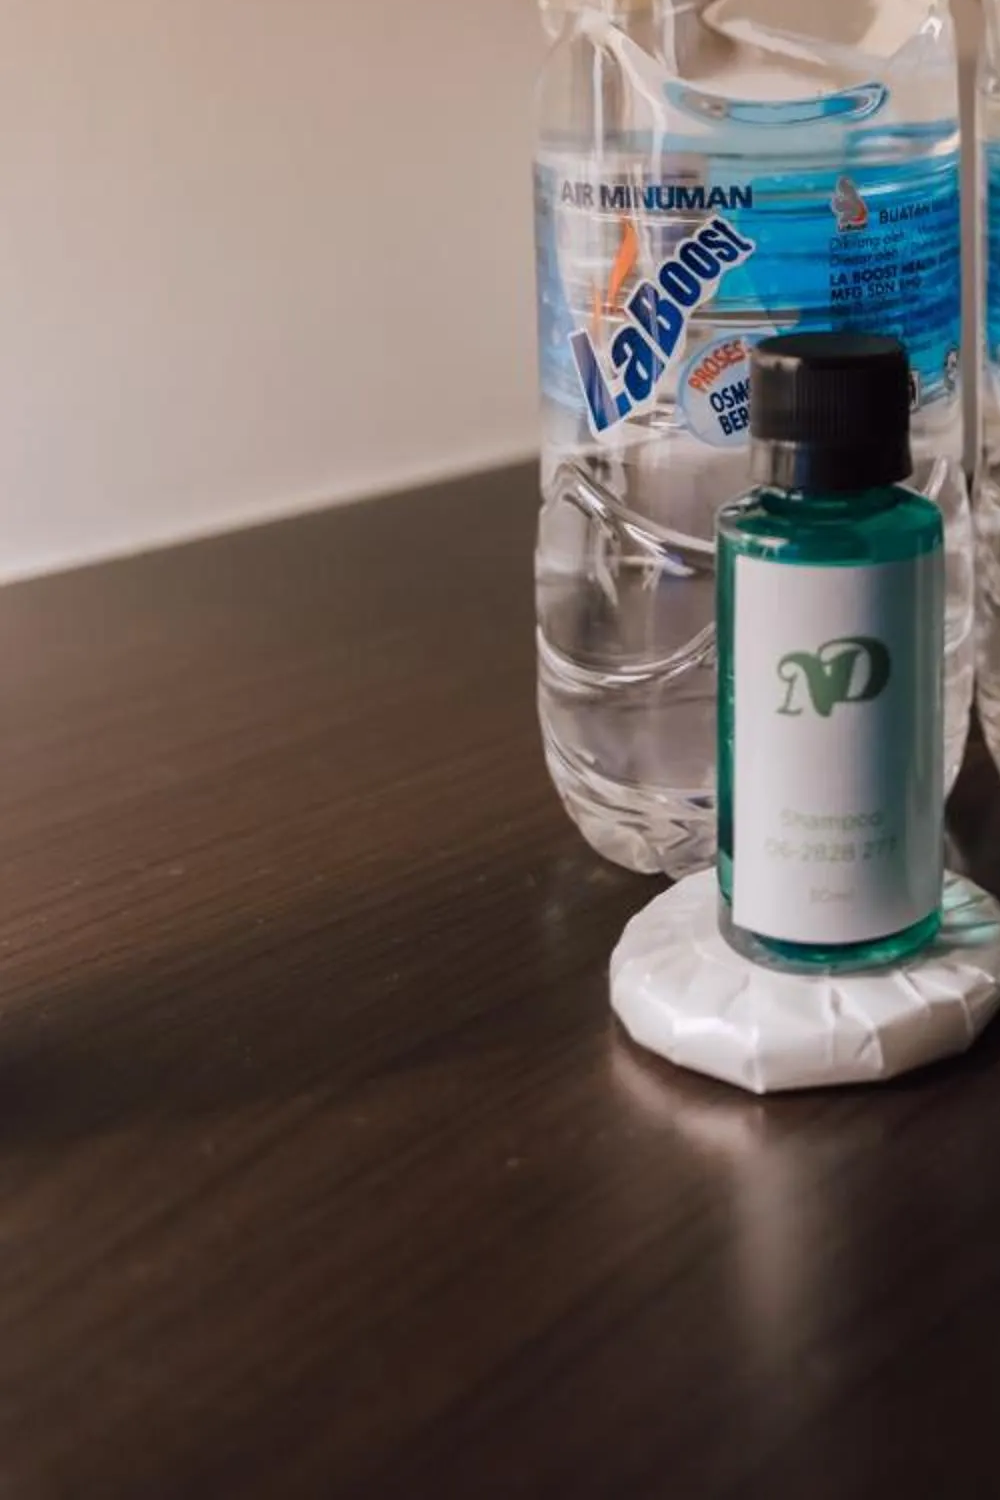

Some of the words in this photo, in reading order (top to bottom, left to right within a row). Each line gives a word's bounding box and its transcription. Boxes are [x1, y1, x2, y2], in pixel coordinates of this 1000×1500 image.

[561, 179, 593, 203] AIR
[599, 184, 753, 211] MINUMAN
[879, 203, 930, 224] BUATAN
[709, 377, 751, 413] OSM
[718, 406, 750, 436] BER
